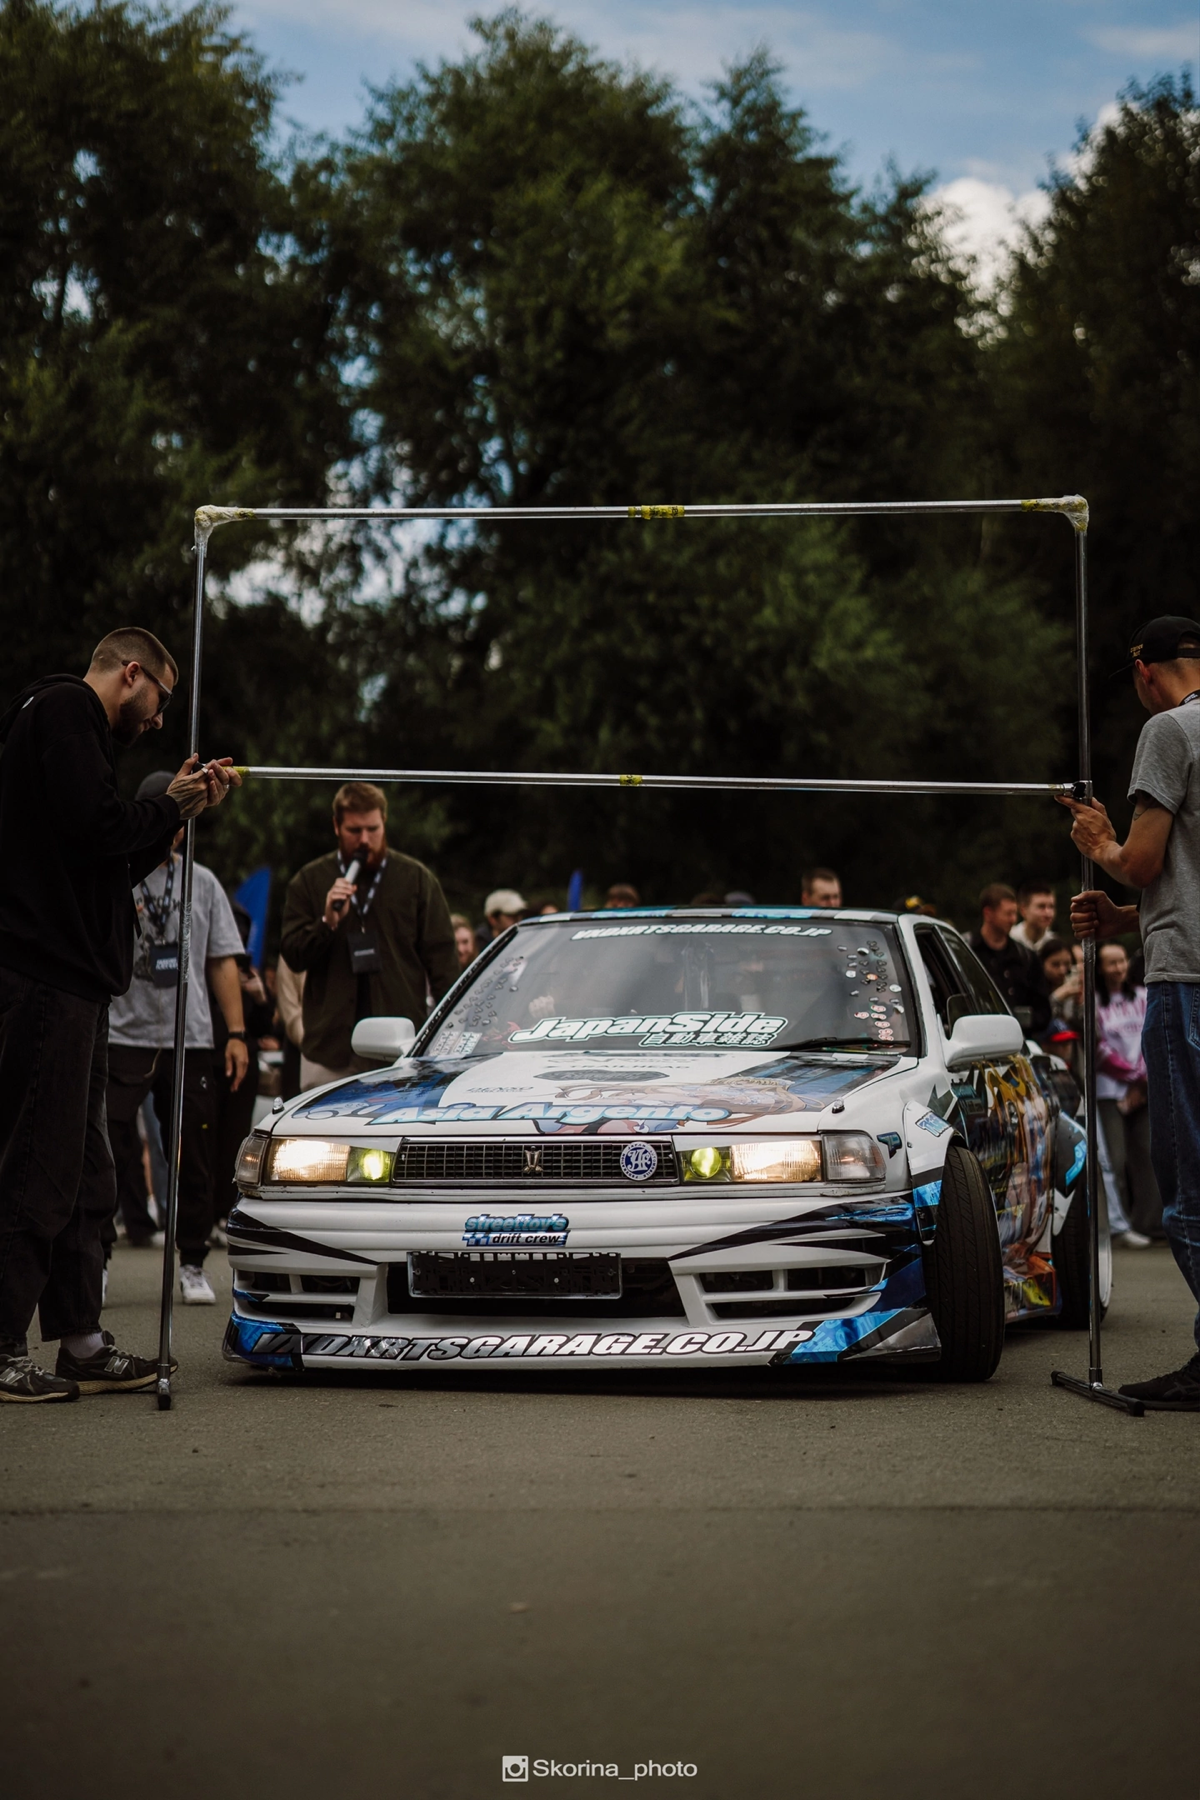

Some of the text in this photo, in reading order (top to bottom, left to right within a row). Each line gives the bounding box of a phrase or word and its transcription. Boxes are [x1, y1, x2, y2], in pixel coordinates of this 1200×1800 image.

[509, 1012, 787, 1042] JapanSide
[377, 1102, 731, 1125] Asia Argento
[492, 1232, 560, 1243] drift crew
